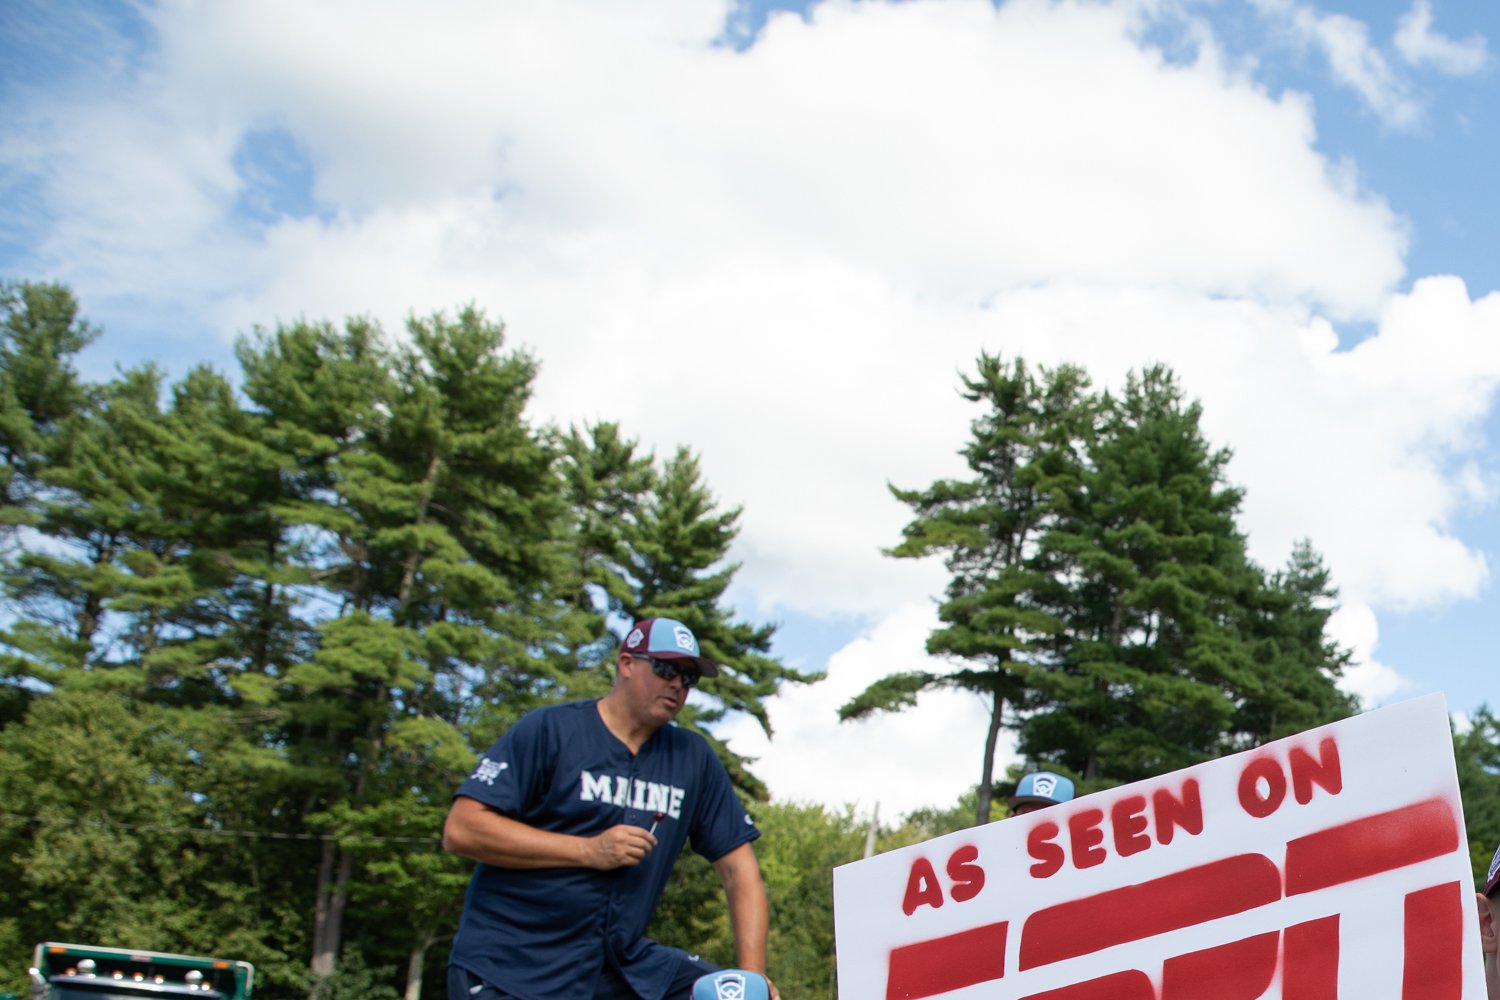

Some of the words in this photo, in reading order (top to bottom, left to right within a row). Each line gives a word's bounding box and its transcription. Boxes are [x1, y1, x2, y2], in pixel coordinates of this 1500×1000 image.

[580, 769, 686, 820] MAINE
[902, 844, 987, 917] AS
[1026, 777, 1204, 879] SEEN
[1237, 736, 1344, 819] ON
